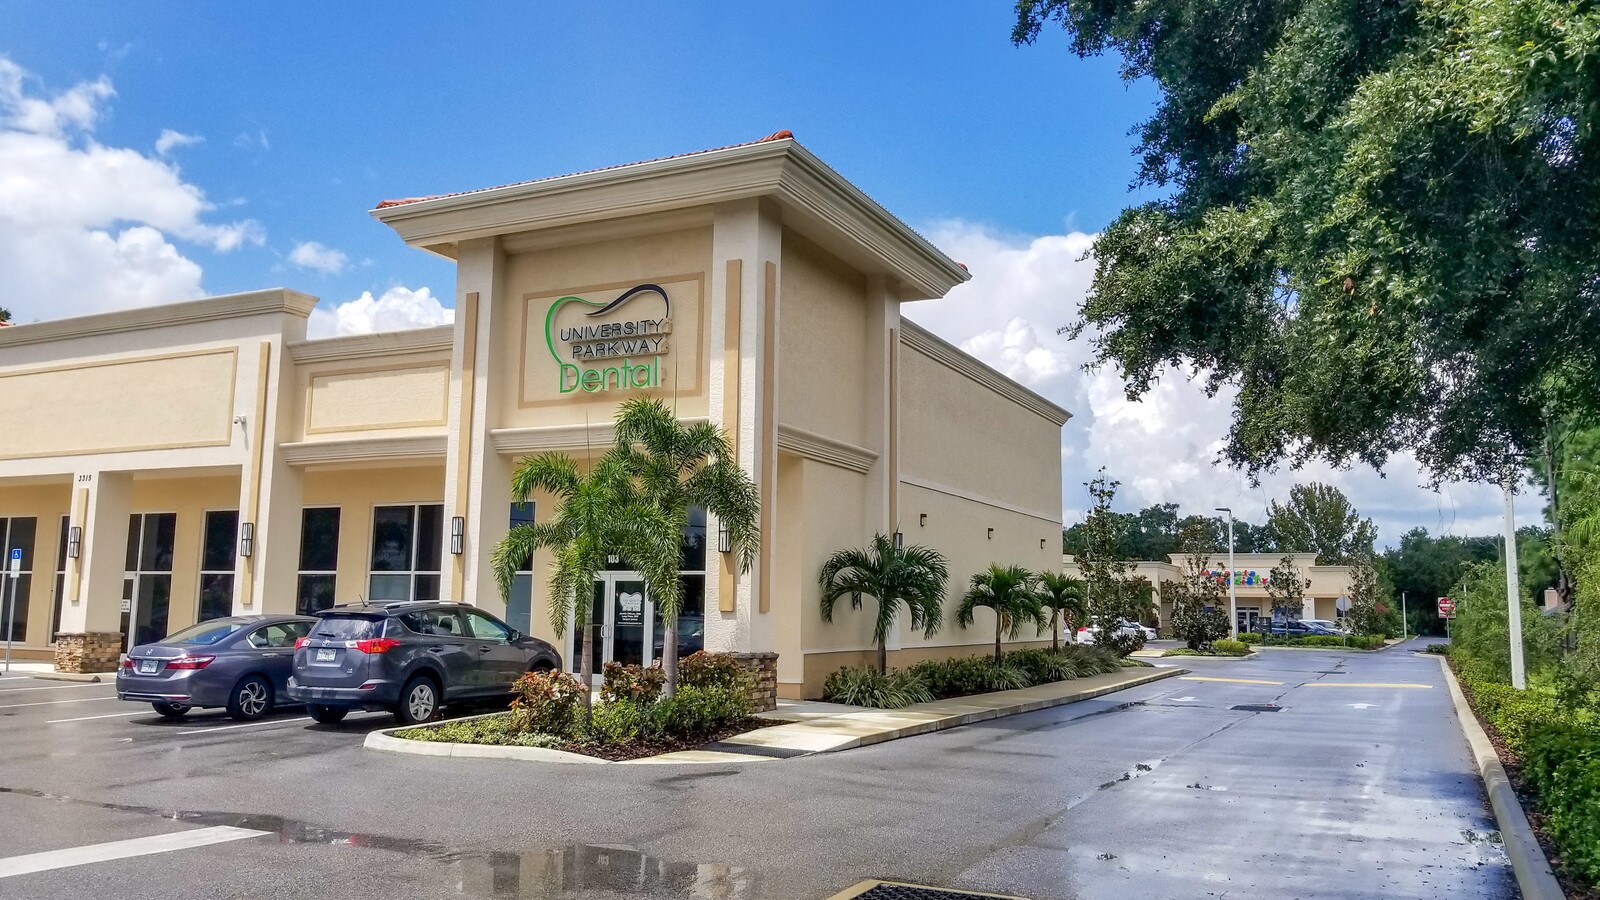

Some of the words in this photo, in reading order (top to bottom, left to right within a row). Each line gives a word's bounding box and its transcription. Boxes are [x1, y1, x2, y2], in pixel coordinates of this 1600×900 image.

[560, 318, 664, 342] UNIVERSITY
[572, 336, 663, 359] PARKWAY
[559, 356, 660, 393] Dental
[78, 474, 92, 482] 3315
[607, 554, 620, 564] 103
